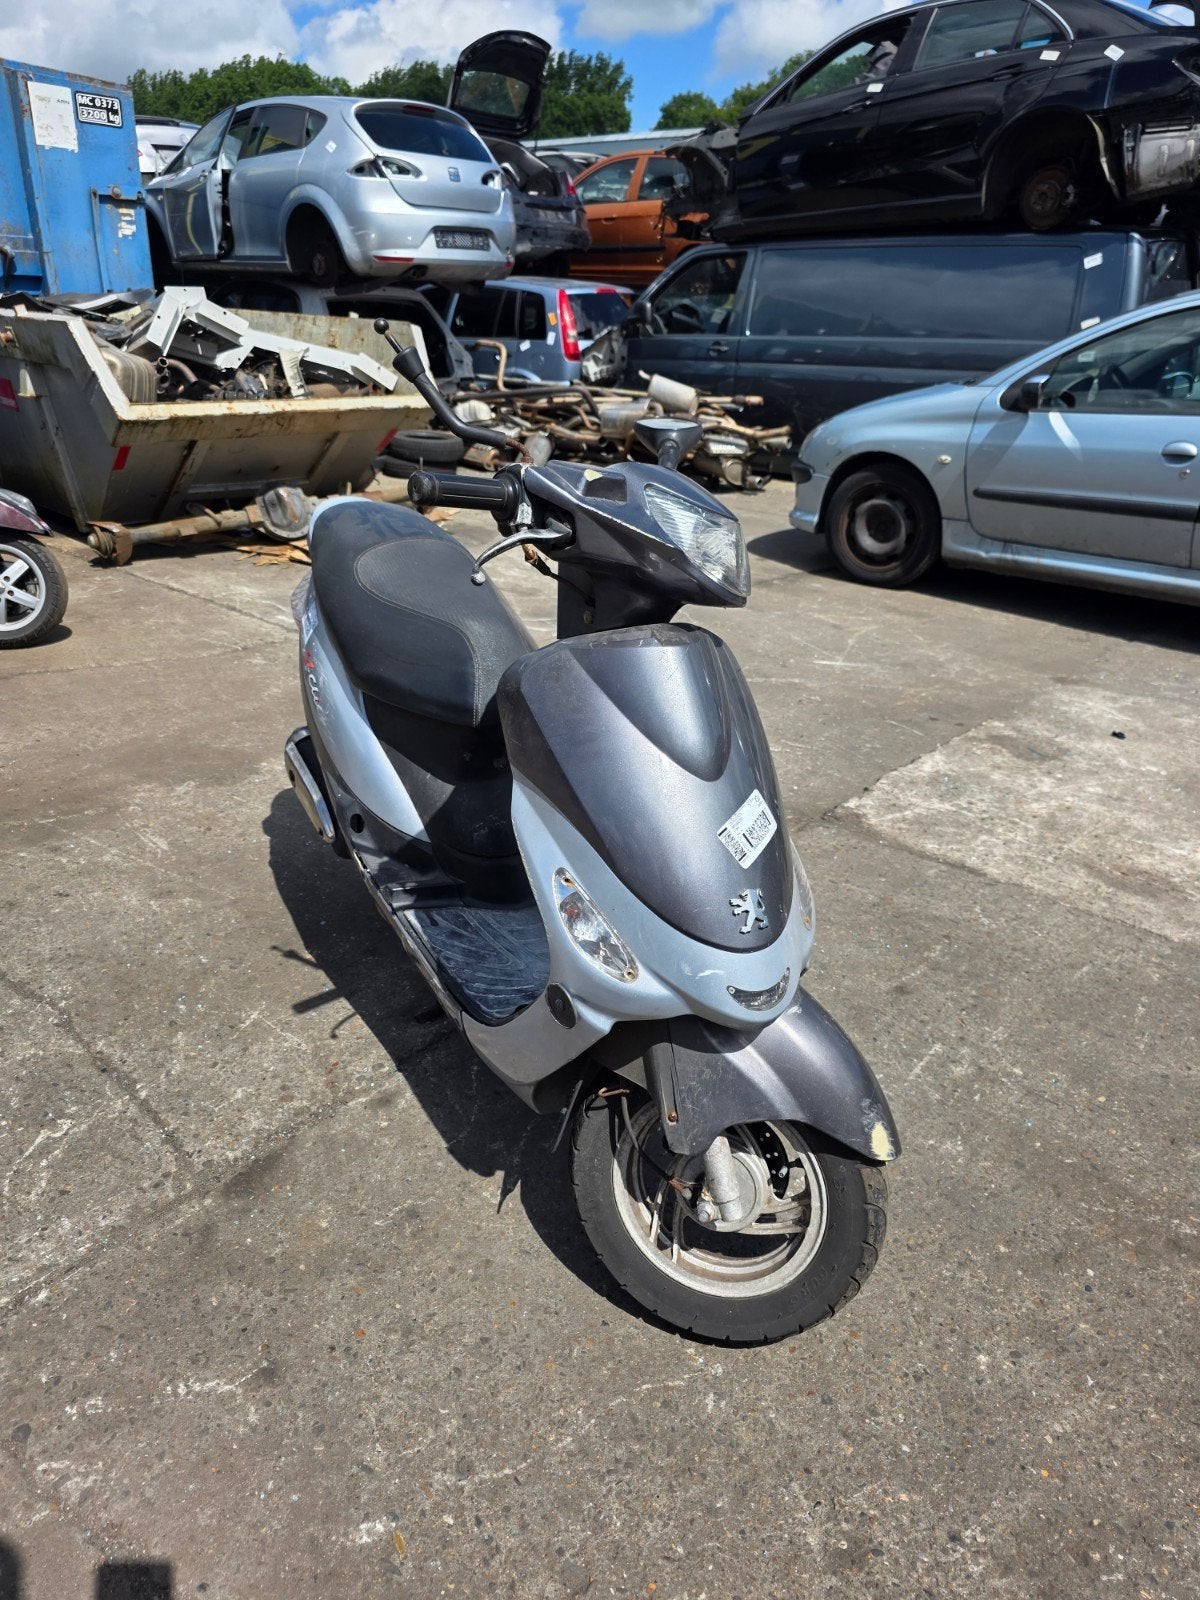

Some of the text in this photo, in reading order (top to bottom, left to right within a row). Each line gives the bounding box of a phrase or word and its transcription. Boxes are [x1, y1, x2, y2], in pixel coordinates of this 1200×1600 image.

[78, 95, 94, 106] MC
[94, 98, 119, 110] 0373
[81, 109, 120, 124] 3200 kg
